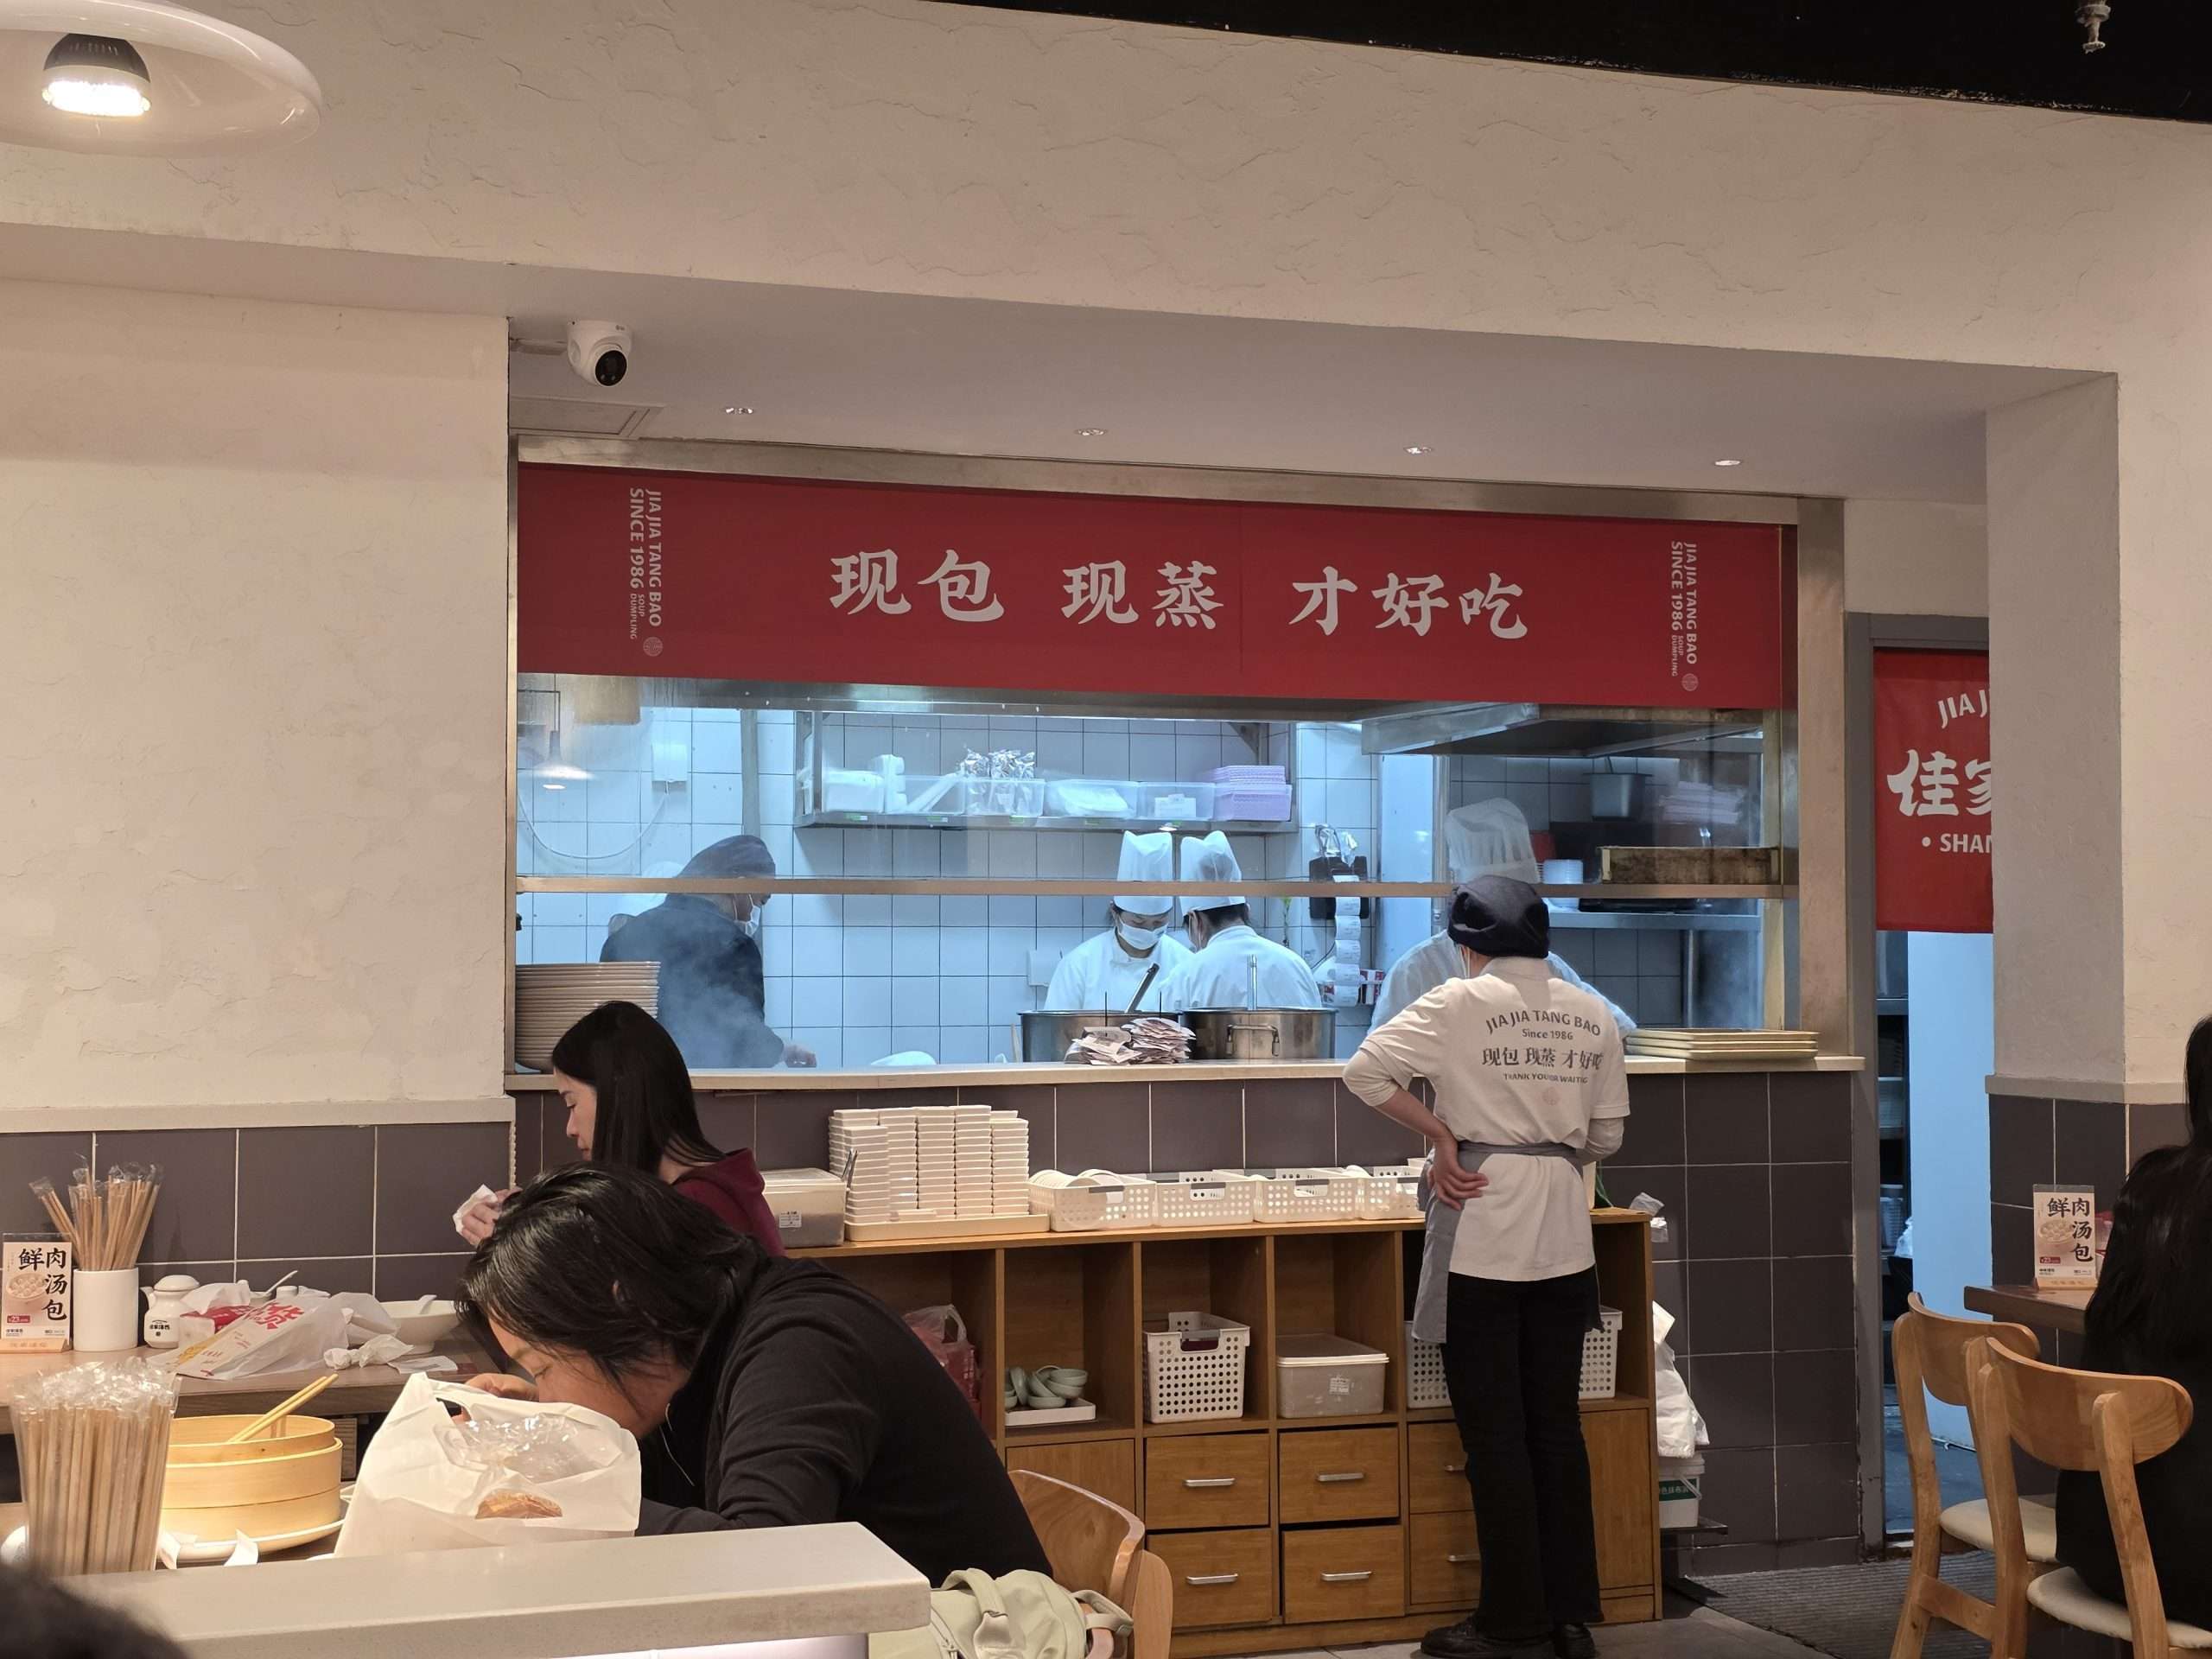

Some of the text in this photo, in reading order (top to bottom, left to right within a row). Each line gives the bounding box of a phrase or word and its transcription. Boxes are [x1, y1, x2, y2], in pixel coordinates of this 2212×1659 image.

[630, 488, 645, 588] SINCE 1986
[649, 543, 662, 588] TANG
[830, 549, 1528, 639] 现包 现蒸 才好吃
[1671, 541, 1683, 631] SINCE 1986
[649, 592, 662, 627] BAO
[1686, 589, 1697, 630] TANG
[1686, 633, 1697, 664] BAO
[1938, 693, 1975, 728] JIA
[1486, 1009, 1601, 1036] JIA JIA TANG BAO
[1522, 1028, 1573, 1040] Since 1986
[1482, 1046, 1519, 1066] 现包
[1525, 1047, 1556, 1067] 现蒸
